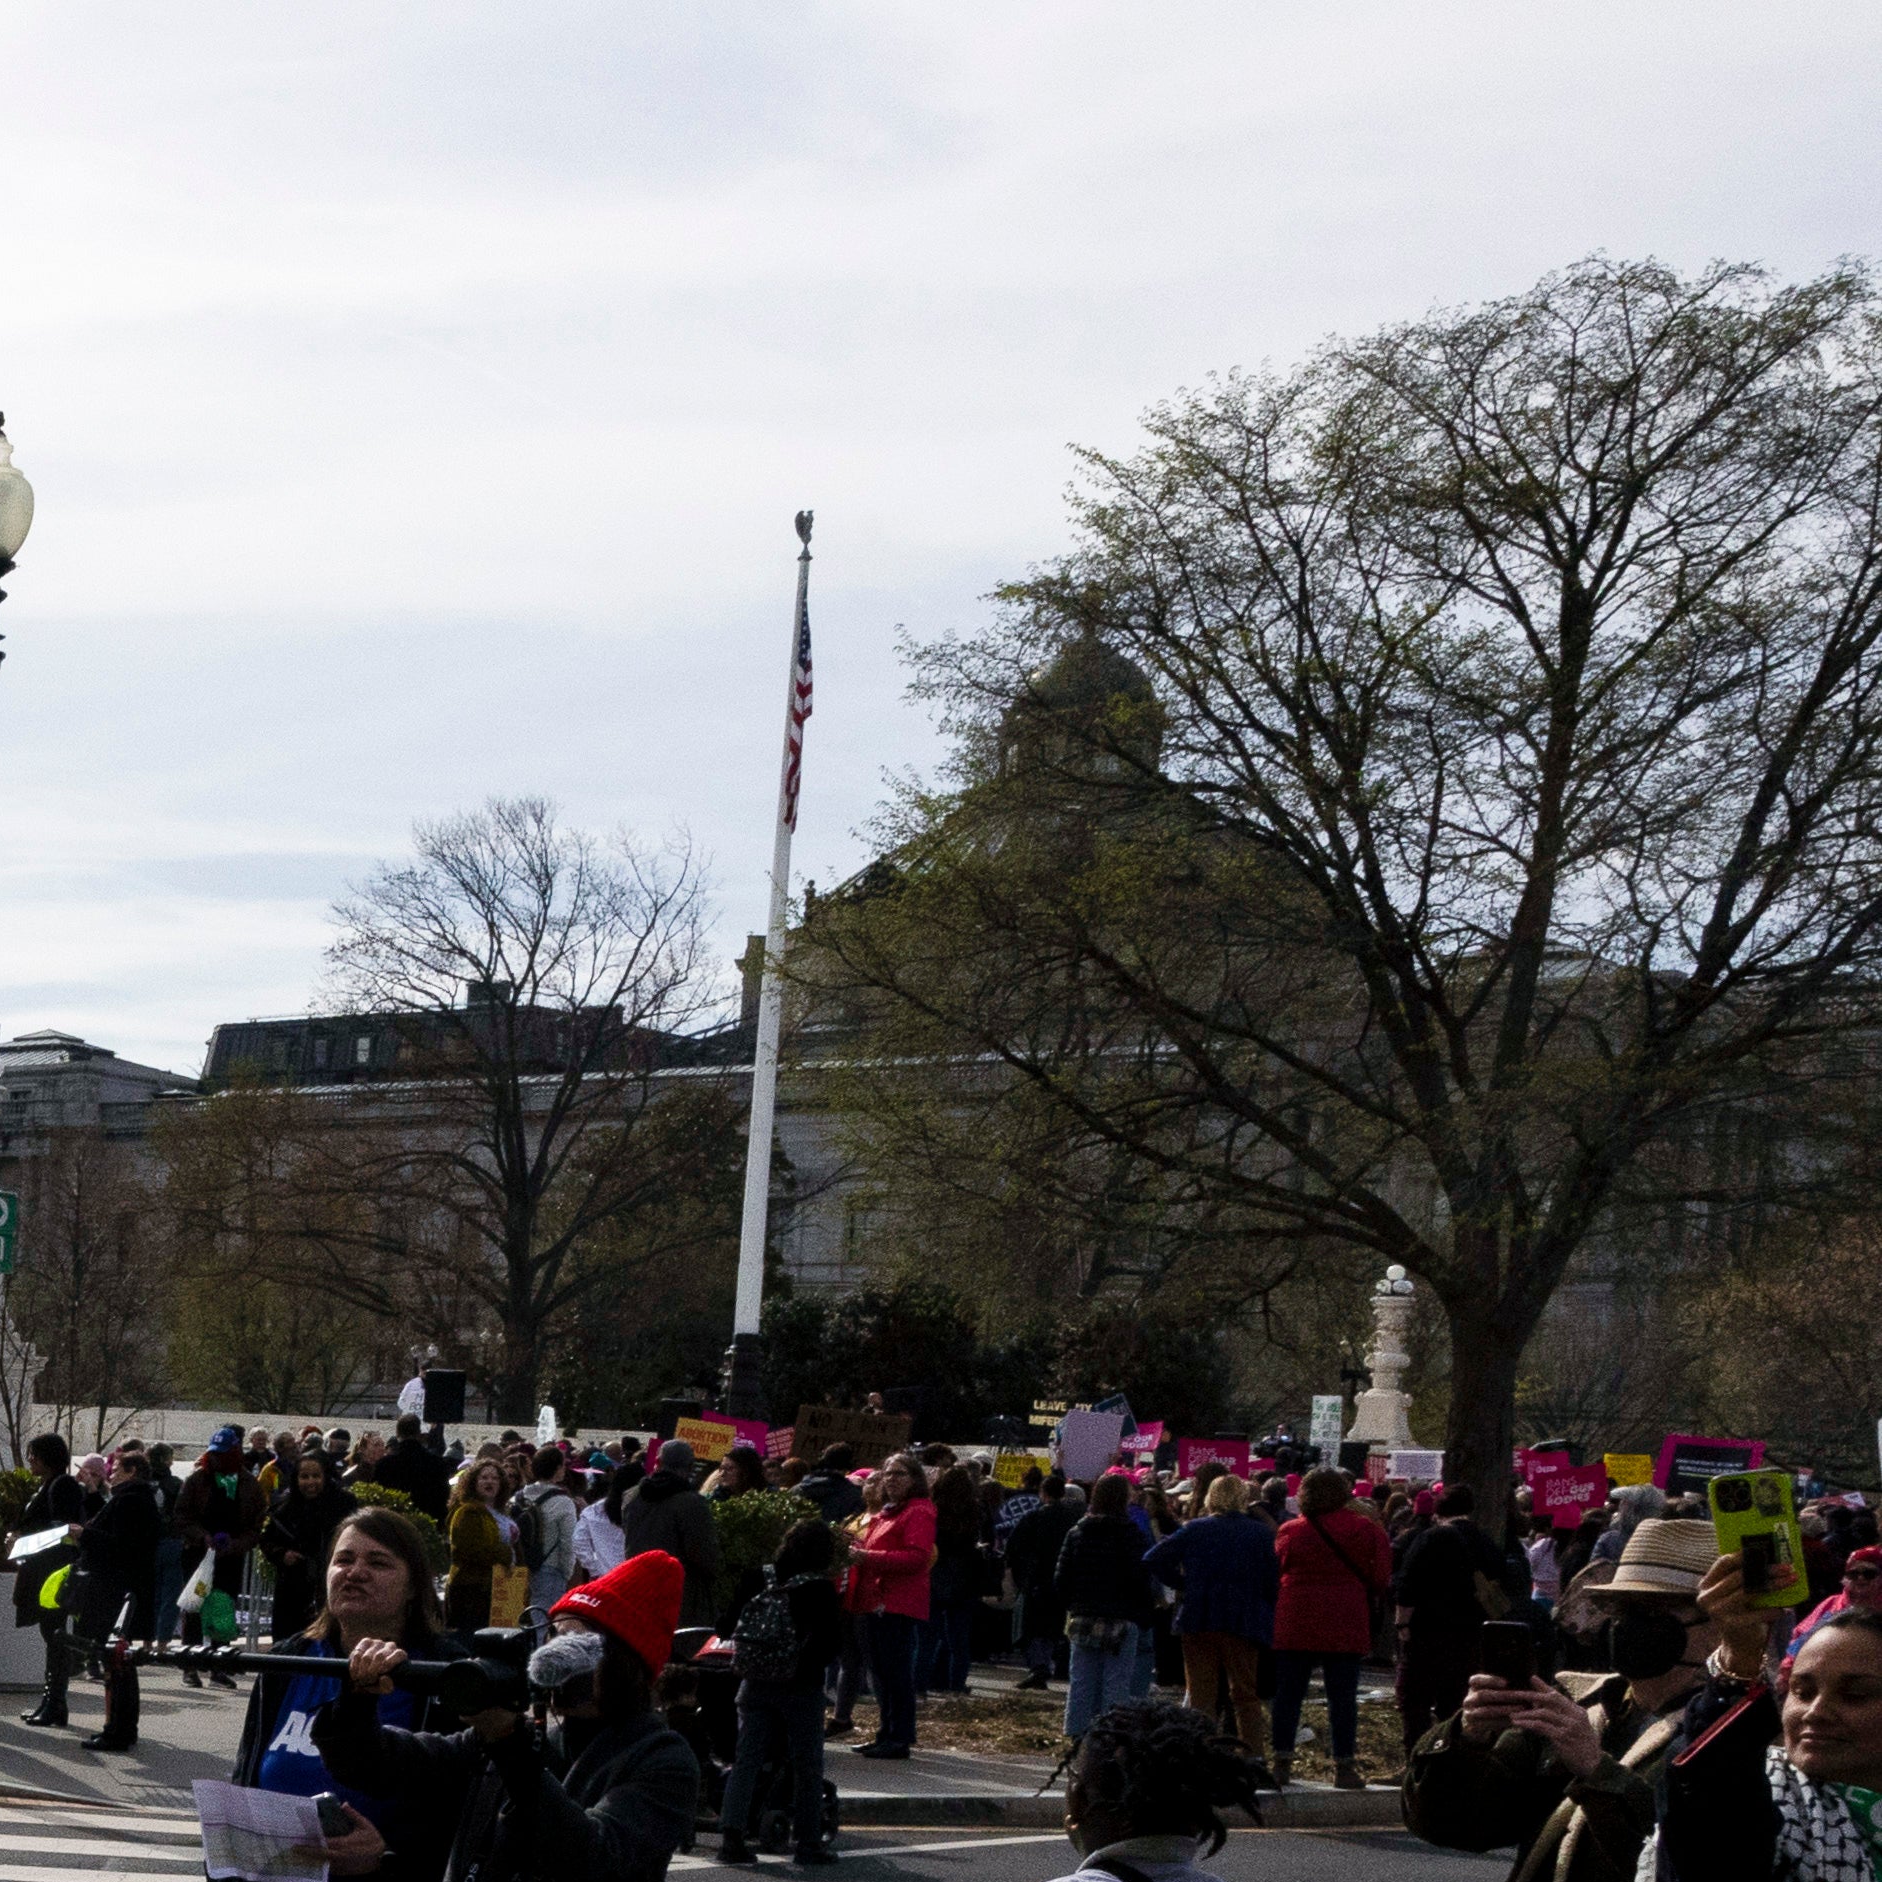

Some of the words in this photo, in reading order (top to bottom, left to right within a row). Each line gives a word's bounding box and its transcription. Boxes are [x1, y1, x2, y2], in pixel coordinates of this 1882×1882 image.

[1033, 1399, 1067, 1412] LEAVE
[1545, 1476, 1577, 1489] BANS
[1569, 1482, 1596, 1495] OUR
[999, 1496, 1041, 1519] KEEP
